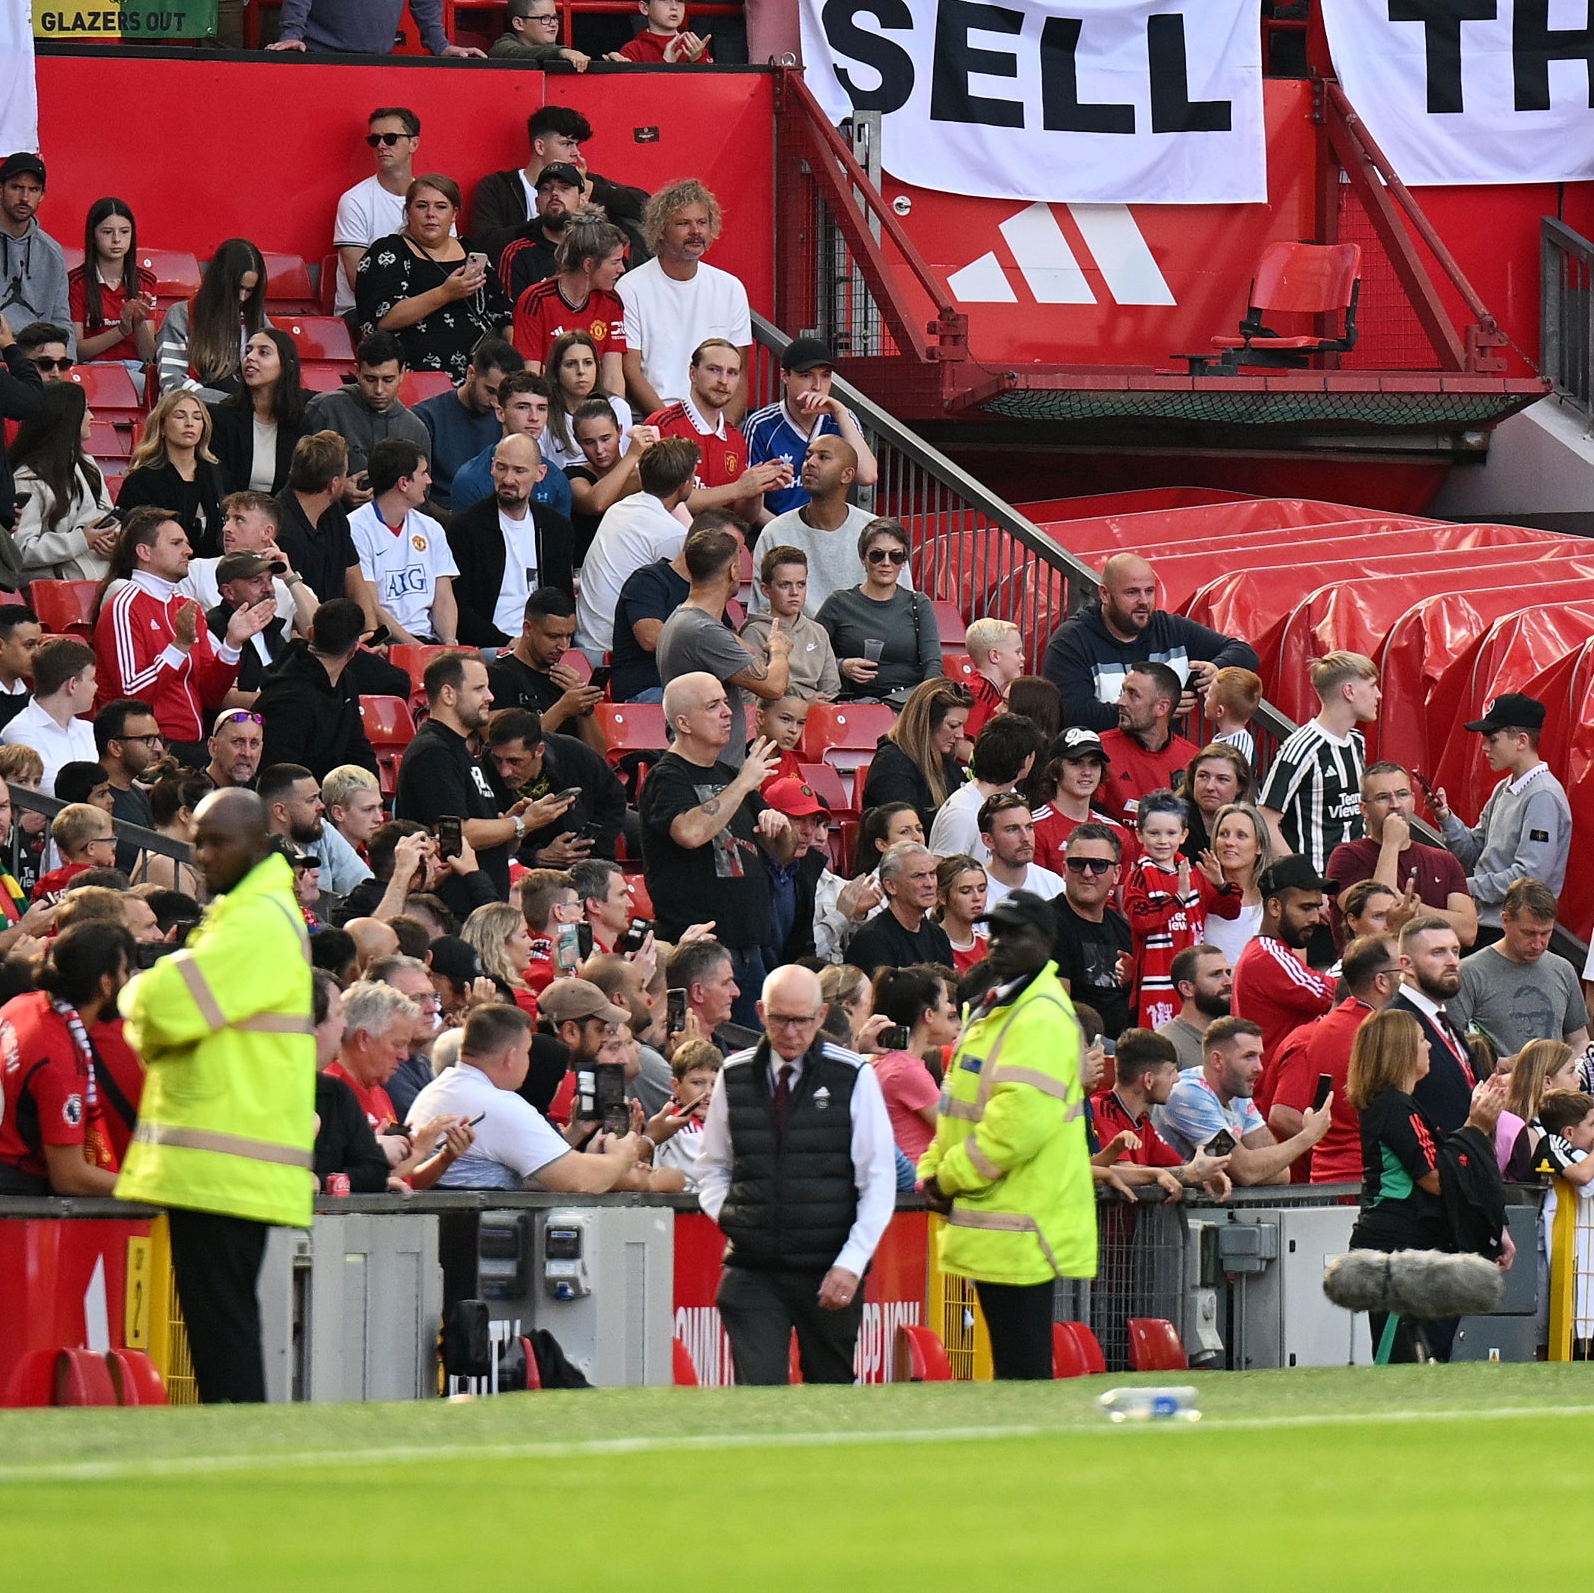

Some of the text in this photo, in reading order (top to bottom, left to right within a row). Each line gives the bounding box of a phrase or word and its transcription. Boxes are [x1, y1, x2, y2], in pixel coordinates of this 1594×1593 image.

[41, 12, 186, 31] GLAZERS OUT
[388, 569, 426, 597] AIG
